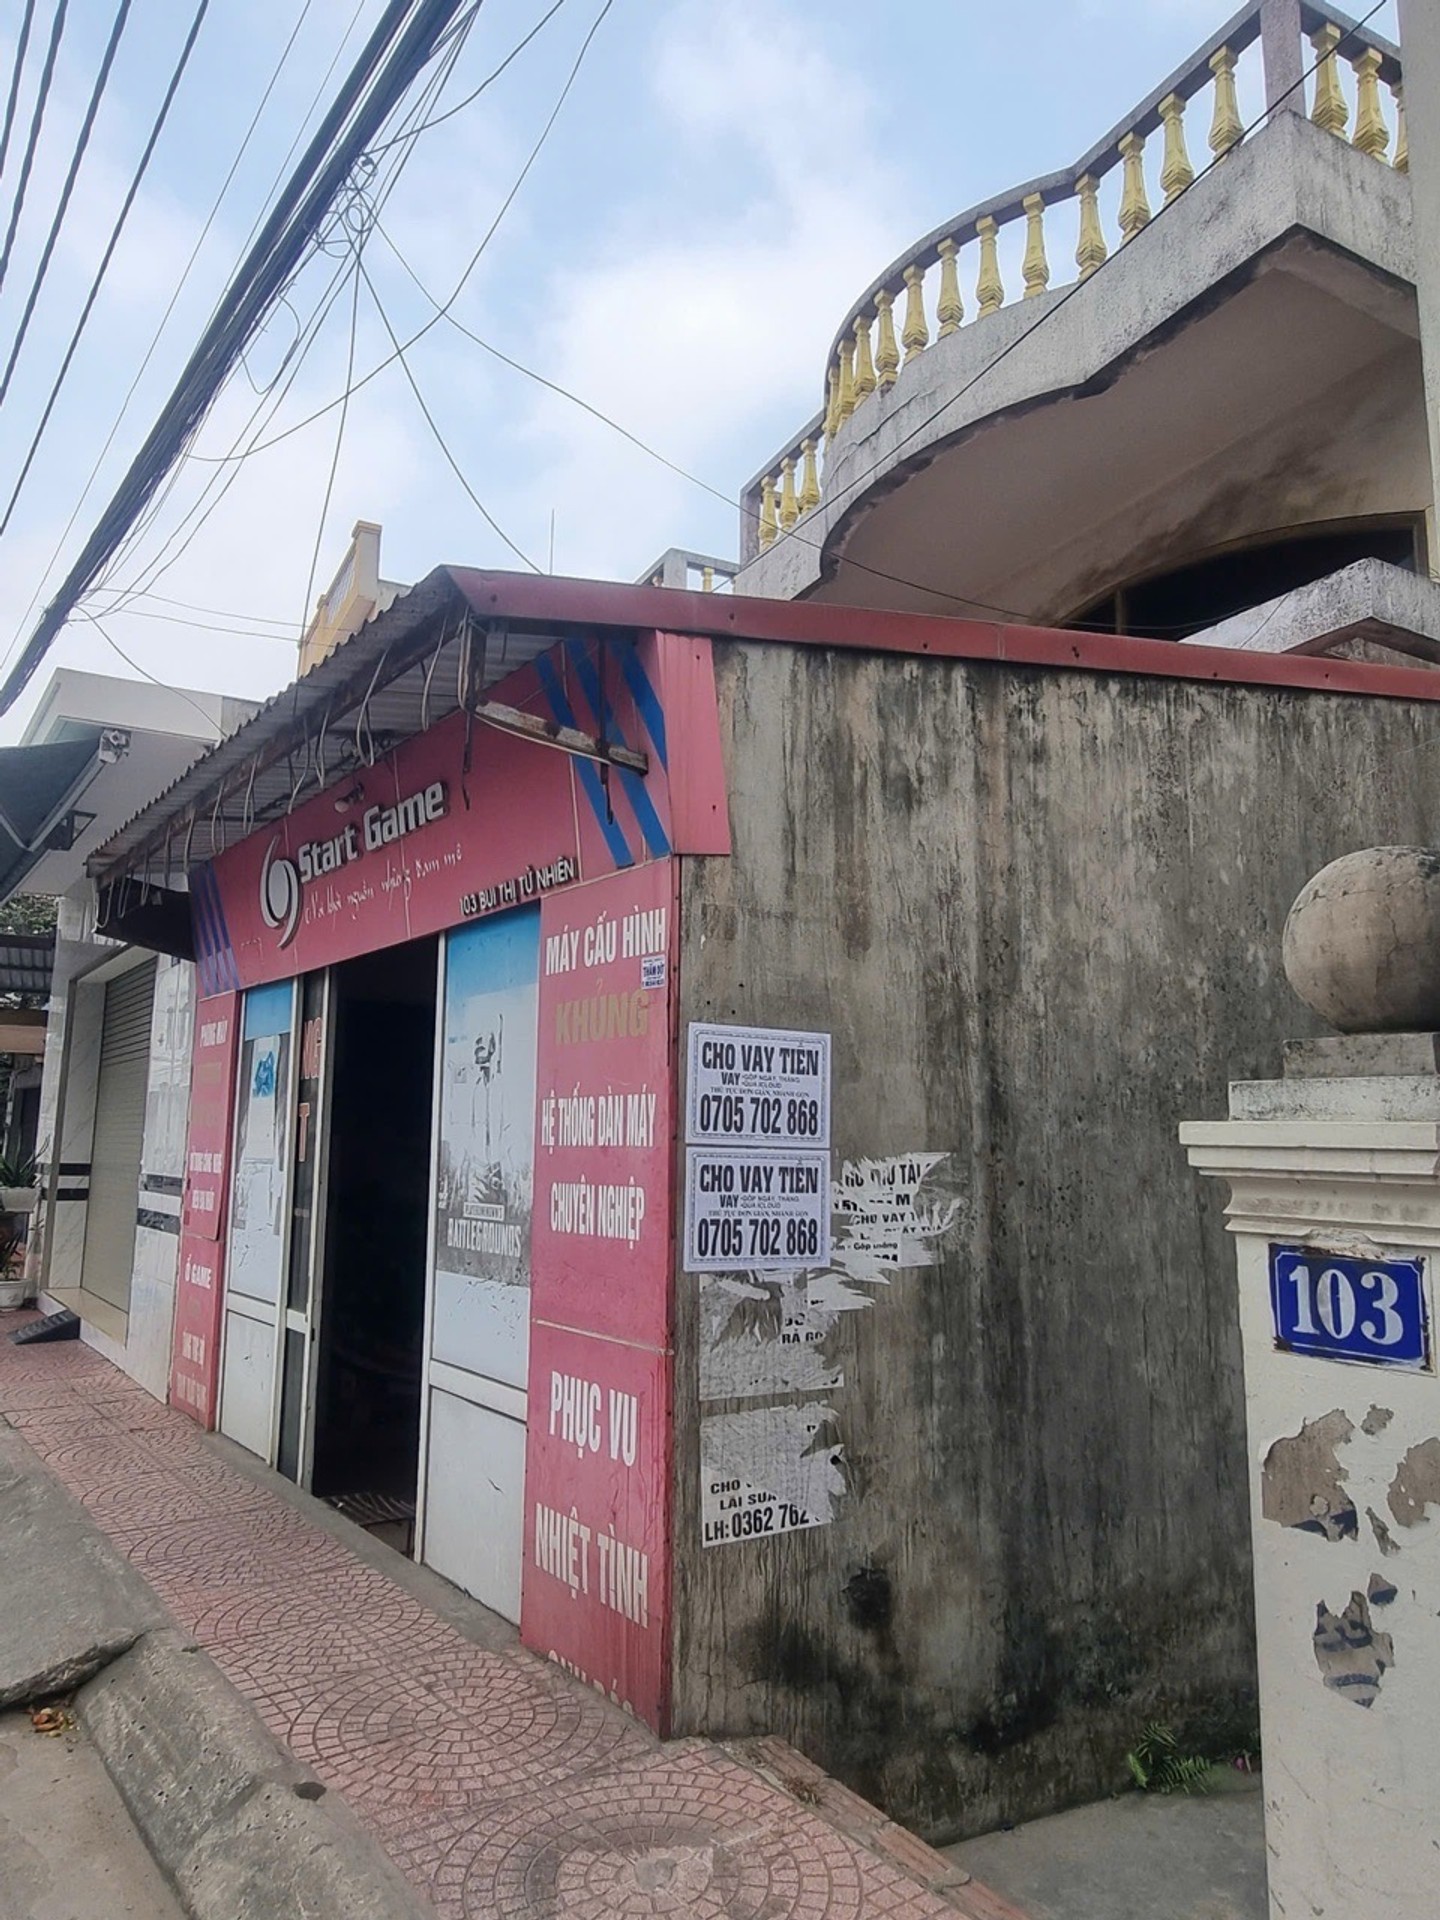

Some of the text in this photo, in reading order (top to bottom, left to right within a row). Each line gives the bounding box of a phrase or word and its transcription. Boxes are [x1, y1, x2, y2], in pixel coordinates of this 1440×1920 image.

[298, 782, 444, 884] Start Game
[459, 894, 477, 915] 103
[536, 856, 575, 888] NHIÊN
[545, 904, 666, 976] MÁY CẤU HÌNH
[702, 1041, 736, 1070] CHO
[741, 1044, 775, 1073] VAY
[721, 1071, 740, 1086] VAY
[541, 1082, 656, 1155] HỆ THỐNG DÀN MÁY
[700, 1094, 818, 1136] 0705 702 868
[700, 1164, 734, 1193] CHO
[740, 1165, 773, 1193] VAY
[719, 1194, 739, 1209] VAY
[551, 1174, 645, 1250] CHUYÊN NGHIỆP
[698, 1218, 817, 1257] 0705 702 868
[1289, 1265, 1404, 1346] 103
[549, 1371, 602, 1459] PHỤC
[710, 1479, 741, 1494] CHO
[535, 1502, 648, 1629] NHIỆT TÌNH
